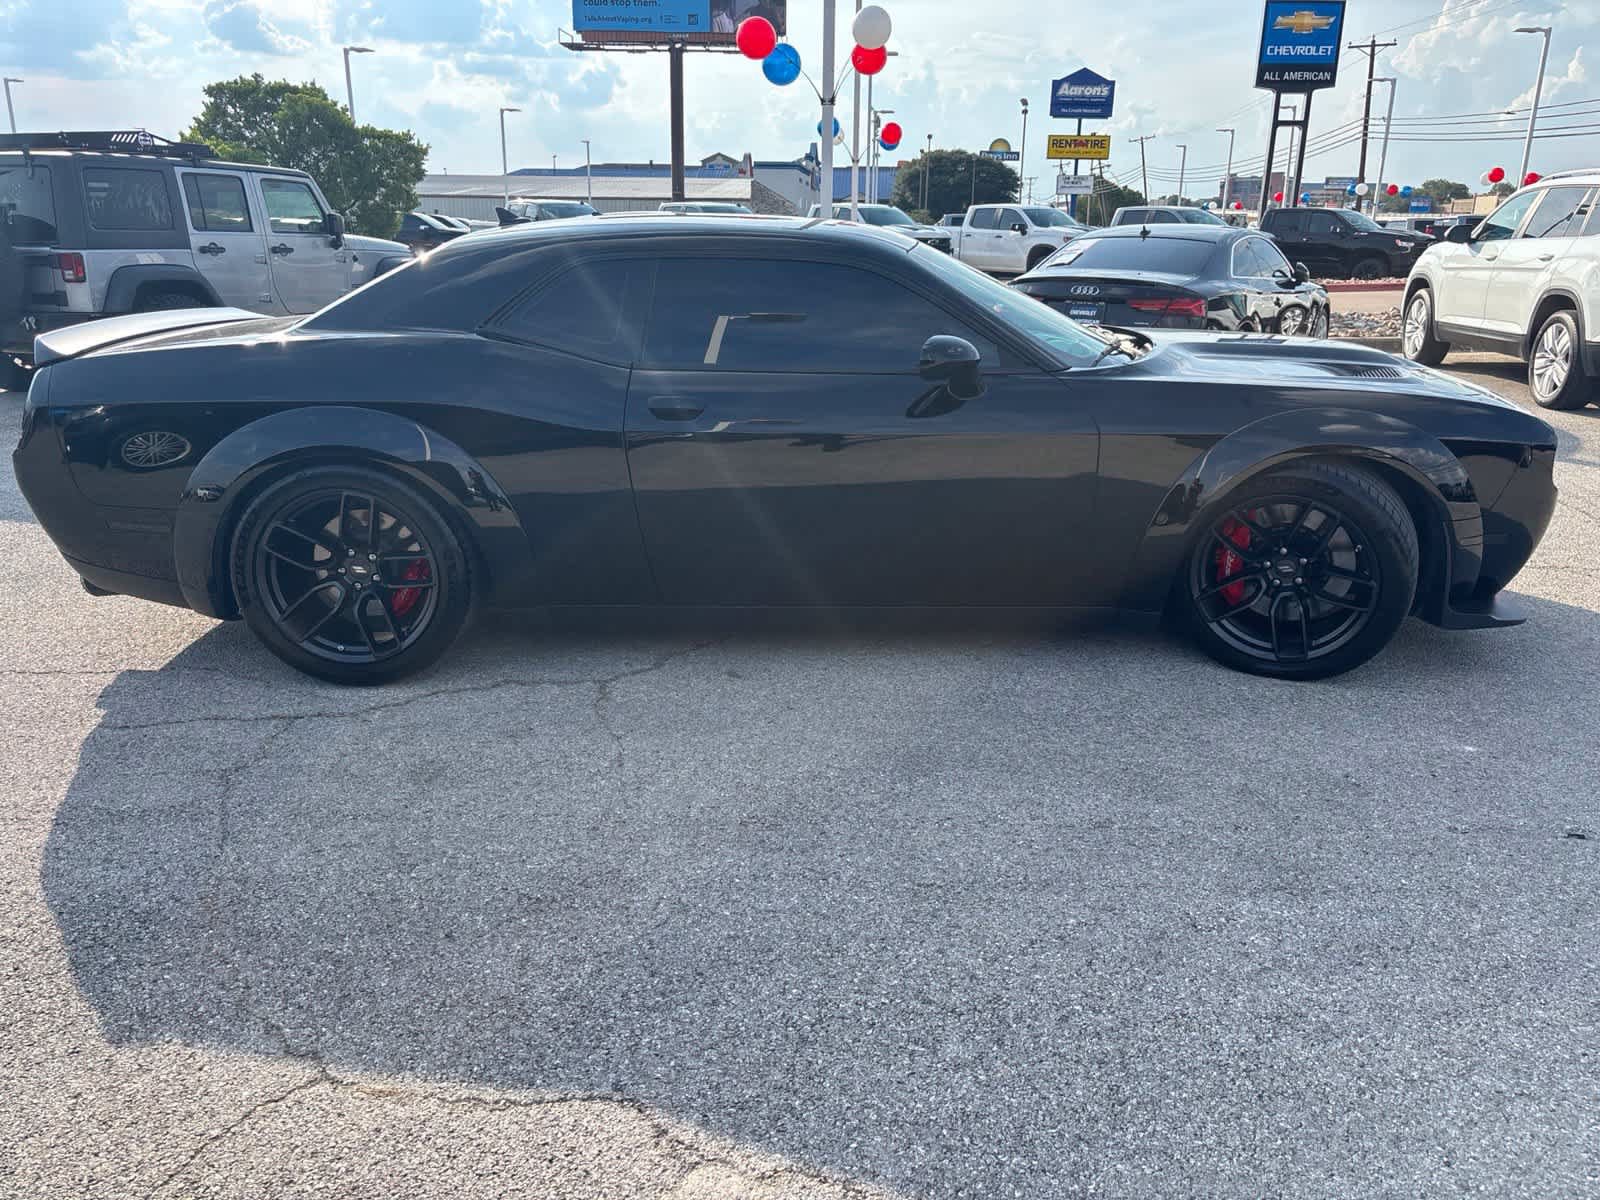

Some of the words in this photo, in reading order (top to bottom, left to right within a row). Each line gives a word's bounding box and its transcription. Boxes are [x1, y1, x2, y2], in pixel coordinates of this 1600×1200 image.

[609, 0, 632, 9] stop
[1266, 45, 1334, 56] CHEVROLET
[1263, 71, 1281, 81] ALL
[1283, 71, 1331, 81] AMERICAN
[1057, 83, 1109, 97] Aaron's
[1051, 138, 1077, 149] RENT
[981, 151, 1002, 161] Days
[1003, 152, 1018, 160] Inn
